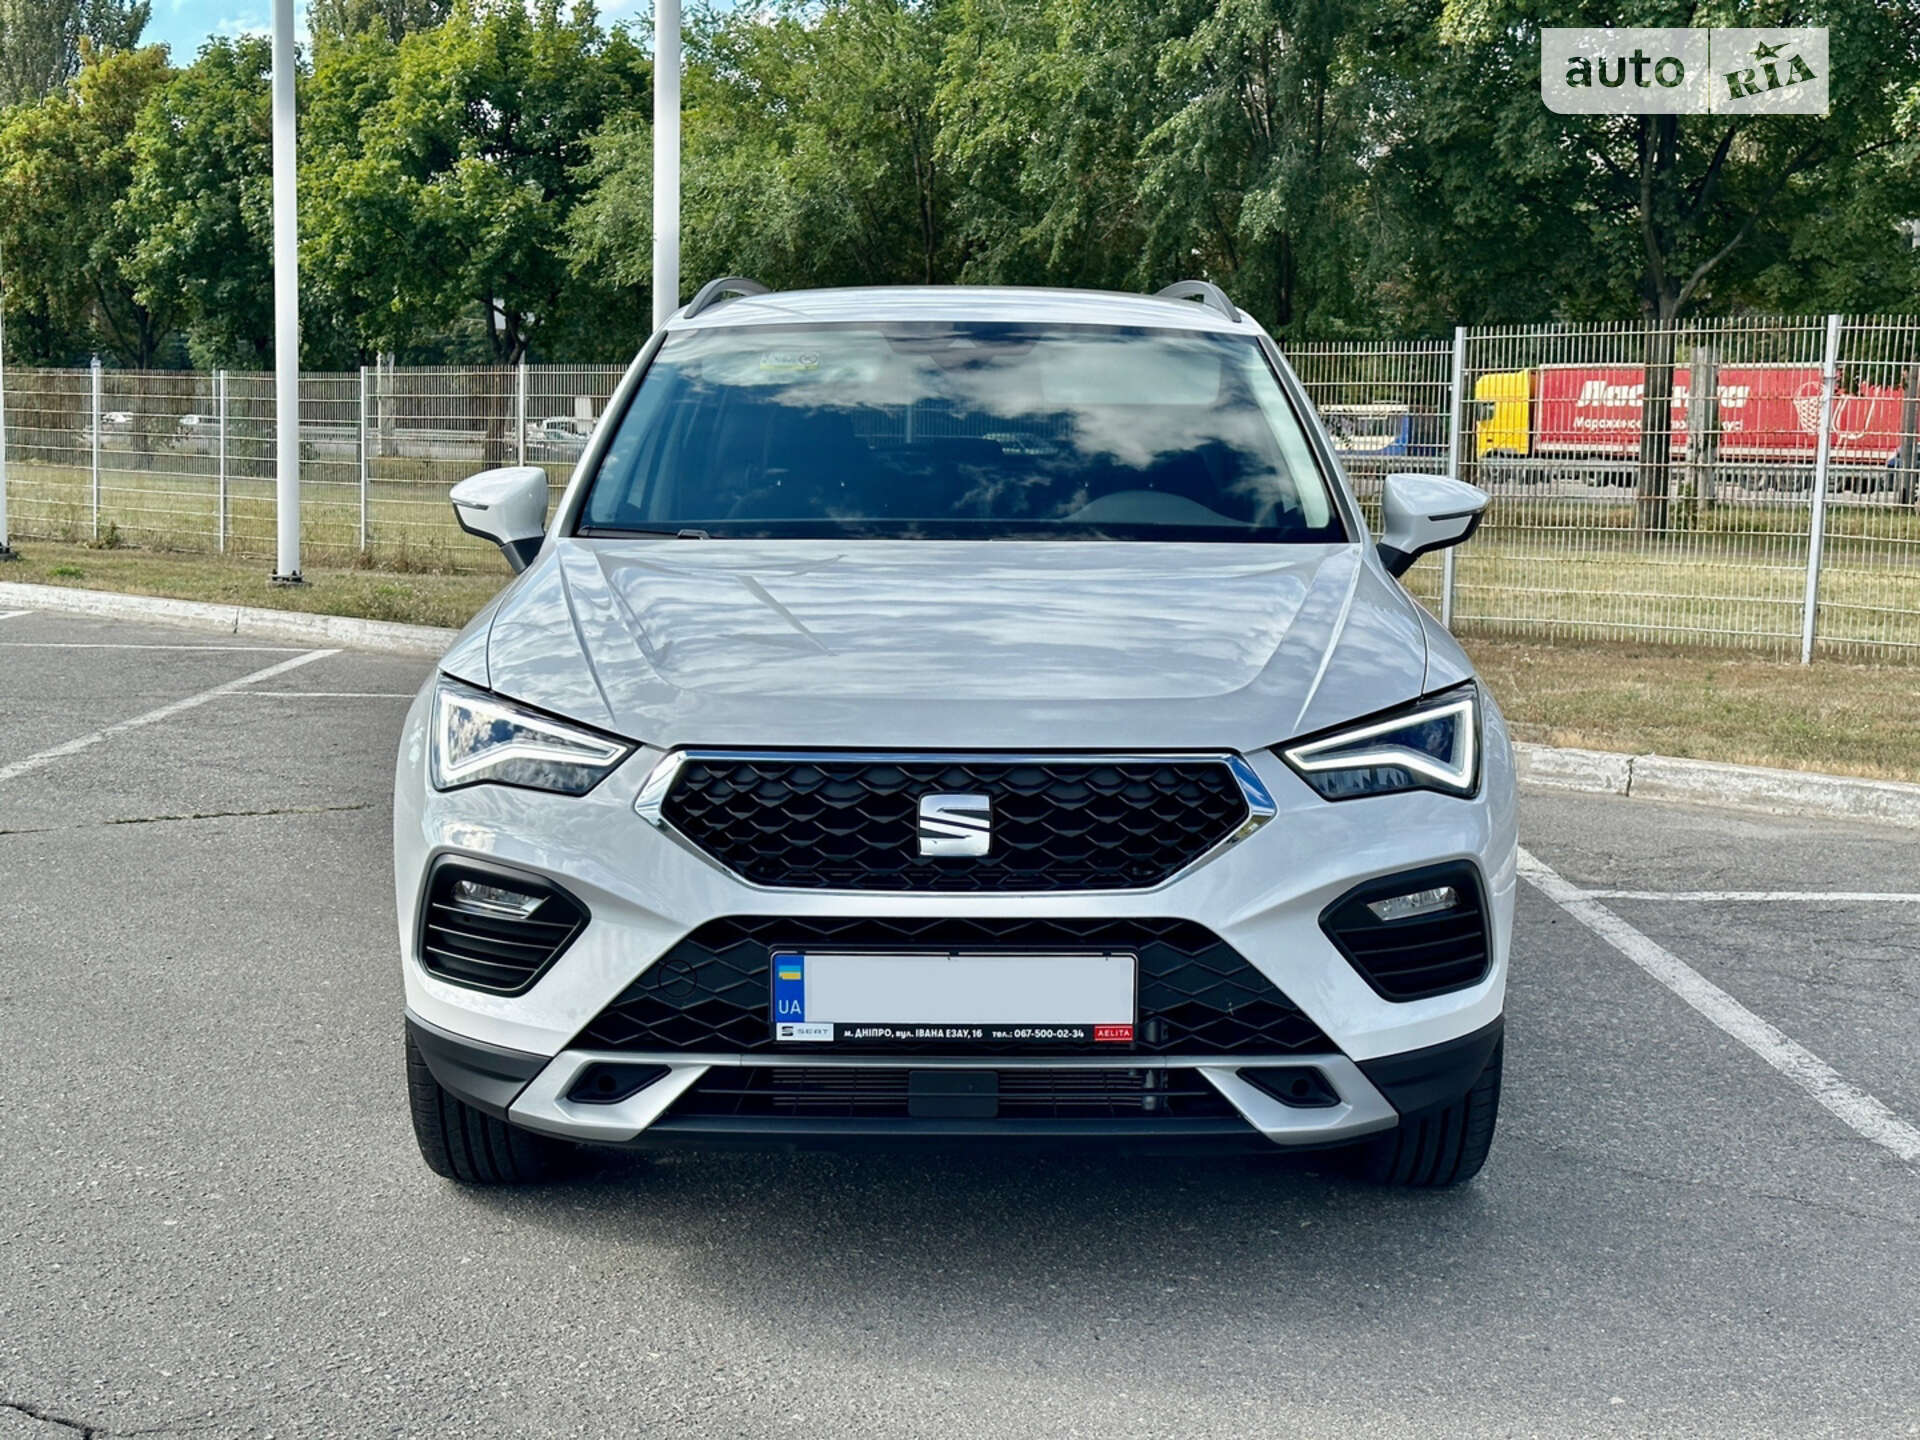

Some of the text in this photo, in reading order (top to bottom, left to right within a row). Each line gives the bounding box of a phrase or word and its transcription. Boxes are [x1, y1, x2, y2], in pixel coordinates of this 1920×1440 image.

[778, 999, 802, 1015] UA
[1014, 1028, 1085, 1039] 067-500-02-34
[1097, 1029, 1131, 1038] AELITA
